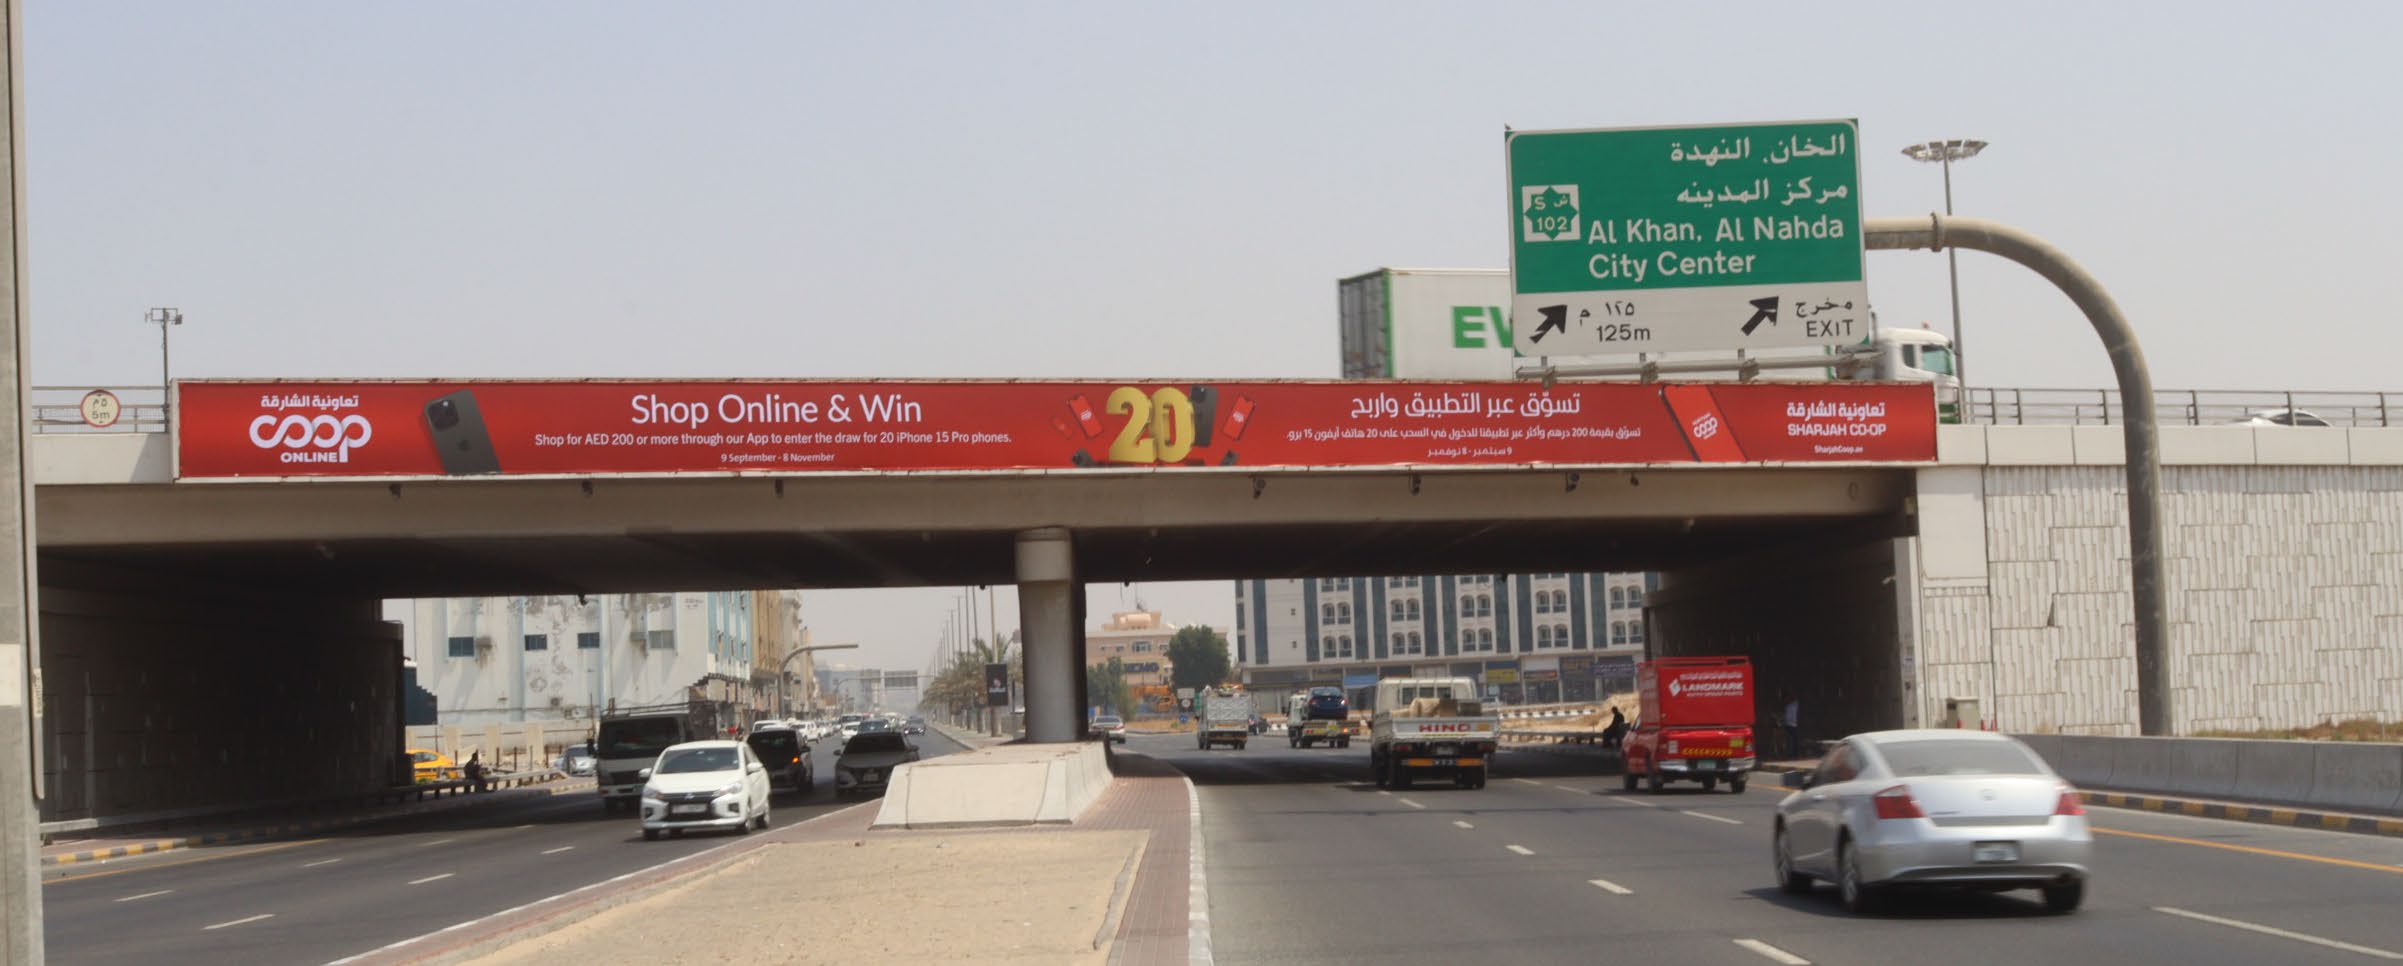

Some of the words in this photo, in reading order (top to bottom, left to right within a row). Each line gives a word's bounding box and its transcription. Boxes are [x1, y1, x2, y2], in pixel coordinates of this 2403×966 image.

[1671, 136, 1750, 167] النهدة
[1677, 177, 1769, 209] المدينه
[1782, 176, 1848, 206] مركز
[1534, 195, 1546, 211] S
[1536, 215, 1568, 235] 102
[1589, 219, 1617, 245] Al
[1716, 217, 1744, 243] Al
[1754, 213, 1843, 241] Nahda
[1589, 253, 1647, 283] City
[1657, 249, 1755, 276] Center
[1605, 300, 1634, 317] ١٢٥
[1796, 297, 1852, 319] مخرج
[1597, 323, 1650, 343] 125m
[1806, 318, 1853, 338] EXIT
[261, 393, 310, 412] الشارقة
[312, 394, 358, 412] تعاونية
[632, 393, 709, 430] Shop
[718, 393, 818, 424] Online
[828, 393, 851, 423] &
[859, 393, 921, 423] Win
[1351, 392, 1398, 419] واربح
[1405, 392, 1480, 419] التطبيق
[1487, 397, 1514, 419] عبر
[1520, 391, 1580, 418] تسوّق
[1787, 399, 1836, 422] الشارقة
[1838, 402, 1885, 422] تعاونية
[1106, 386, 1196, 464] 20
[1304, 428, 1312, 439] 15
[1341, 427, 1365, 439] هاتف
[1367, 427, 1378, 439] 20
[1379, 427, 1398, 438] على
[1400, 427, 1429, 439] السحب
[1431, 428, 1447, 440] في
[1449, 427, 1478, 441] للدخول
[1480, 427, 1509, 439] تطبيقنا
[1547, 428, 1570, 440] درهم
[1572, 427, 1588, 438] 200
[1589, 427, 1614, 439] بقيمة
[1788, 423, 1847, 437] SHARJAH
[1850, 423, 1886, 437] CO-OP
[535, 433, 564, 448] Shop
[567, 433, 582, 446] for
[585, 433, 609, 446] AED
[612, 432, 634, 446] 200
[636, 435, 648, 446] or
[651, 435, 678, 445] more
[681, 432, 723, 447] through
[726, 434, 744, 445] our
[747, 432, 768, 446] App
[771, 432, 782, 444] to
[784, 432, 812, 445] enter
[815, 431, 832, 444] the
[835, 431, 861, 444] draw
[863, 431, 877, 444] for
[880, 431, 894, 444] 20
[897, 431, 933, 444] iPhone
[936, 430, 949, 443] 15
[952, 431, 969, 443] Pro
[972, 431, 1011, 445] phones.
[1511, 429, 1523, 441] عبر
[281, 451, 337, 464] ONLINE
[721, 453, 727, 463] 9
[729, 452, 776, 465] September
[783, 452, 789, 462] 8
[790, 452, 835, 462] November
